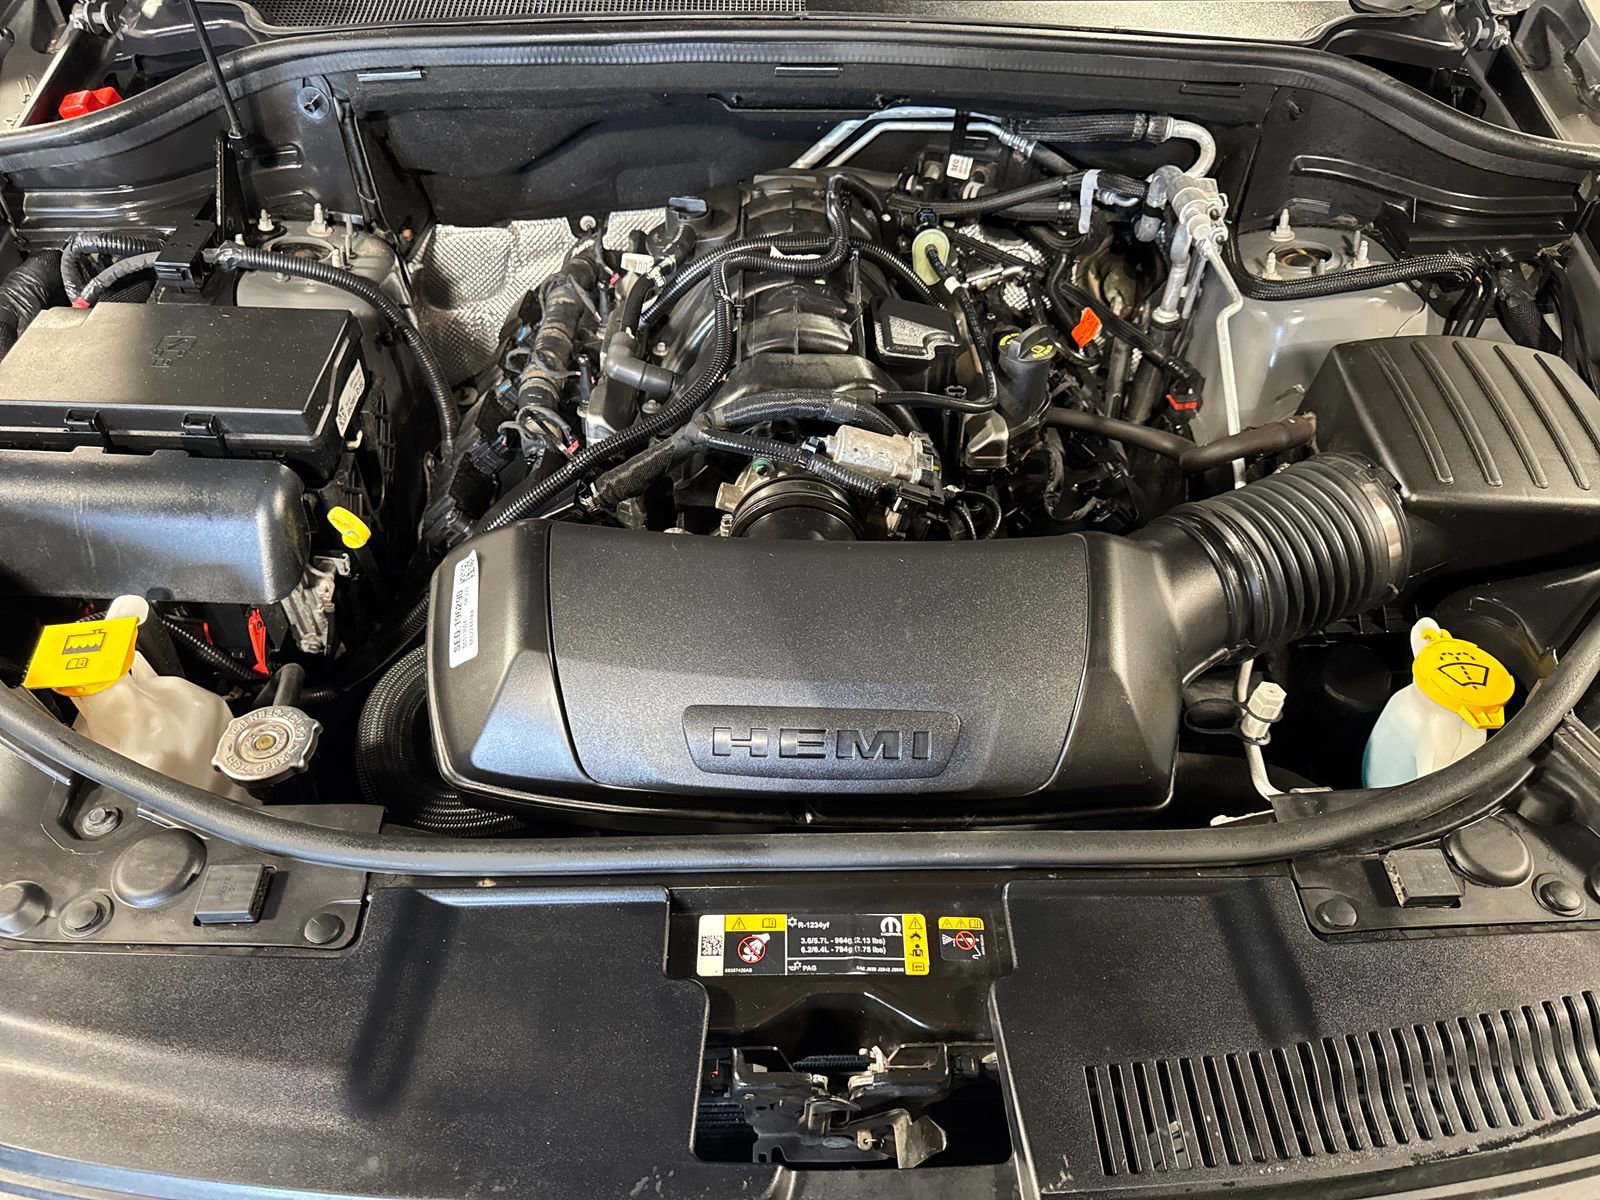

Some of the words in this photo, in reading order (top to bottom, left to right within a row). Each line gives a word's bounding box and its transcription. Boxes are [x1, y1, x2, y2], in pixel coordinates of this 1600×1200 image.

[712, 726, 931, 760] HEMI
[798, 921, 830, 930] R-1234yf
[800, 937, 830, 945] 3.6/5.7L
[872, 937, 887, 946] lbs)
[872, 946, 887, 955] lbs)
